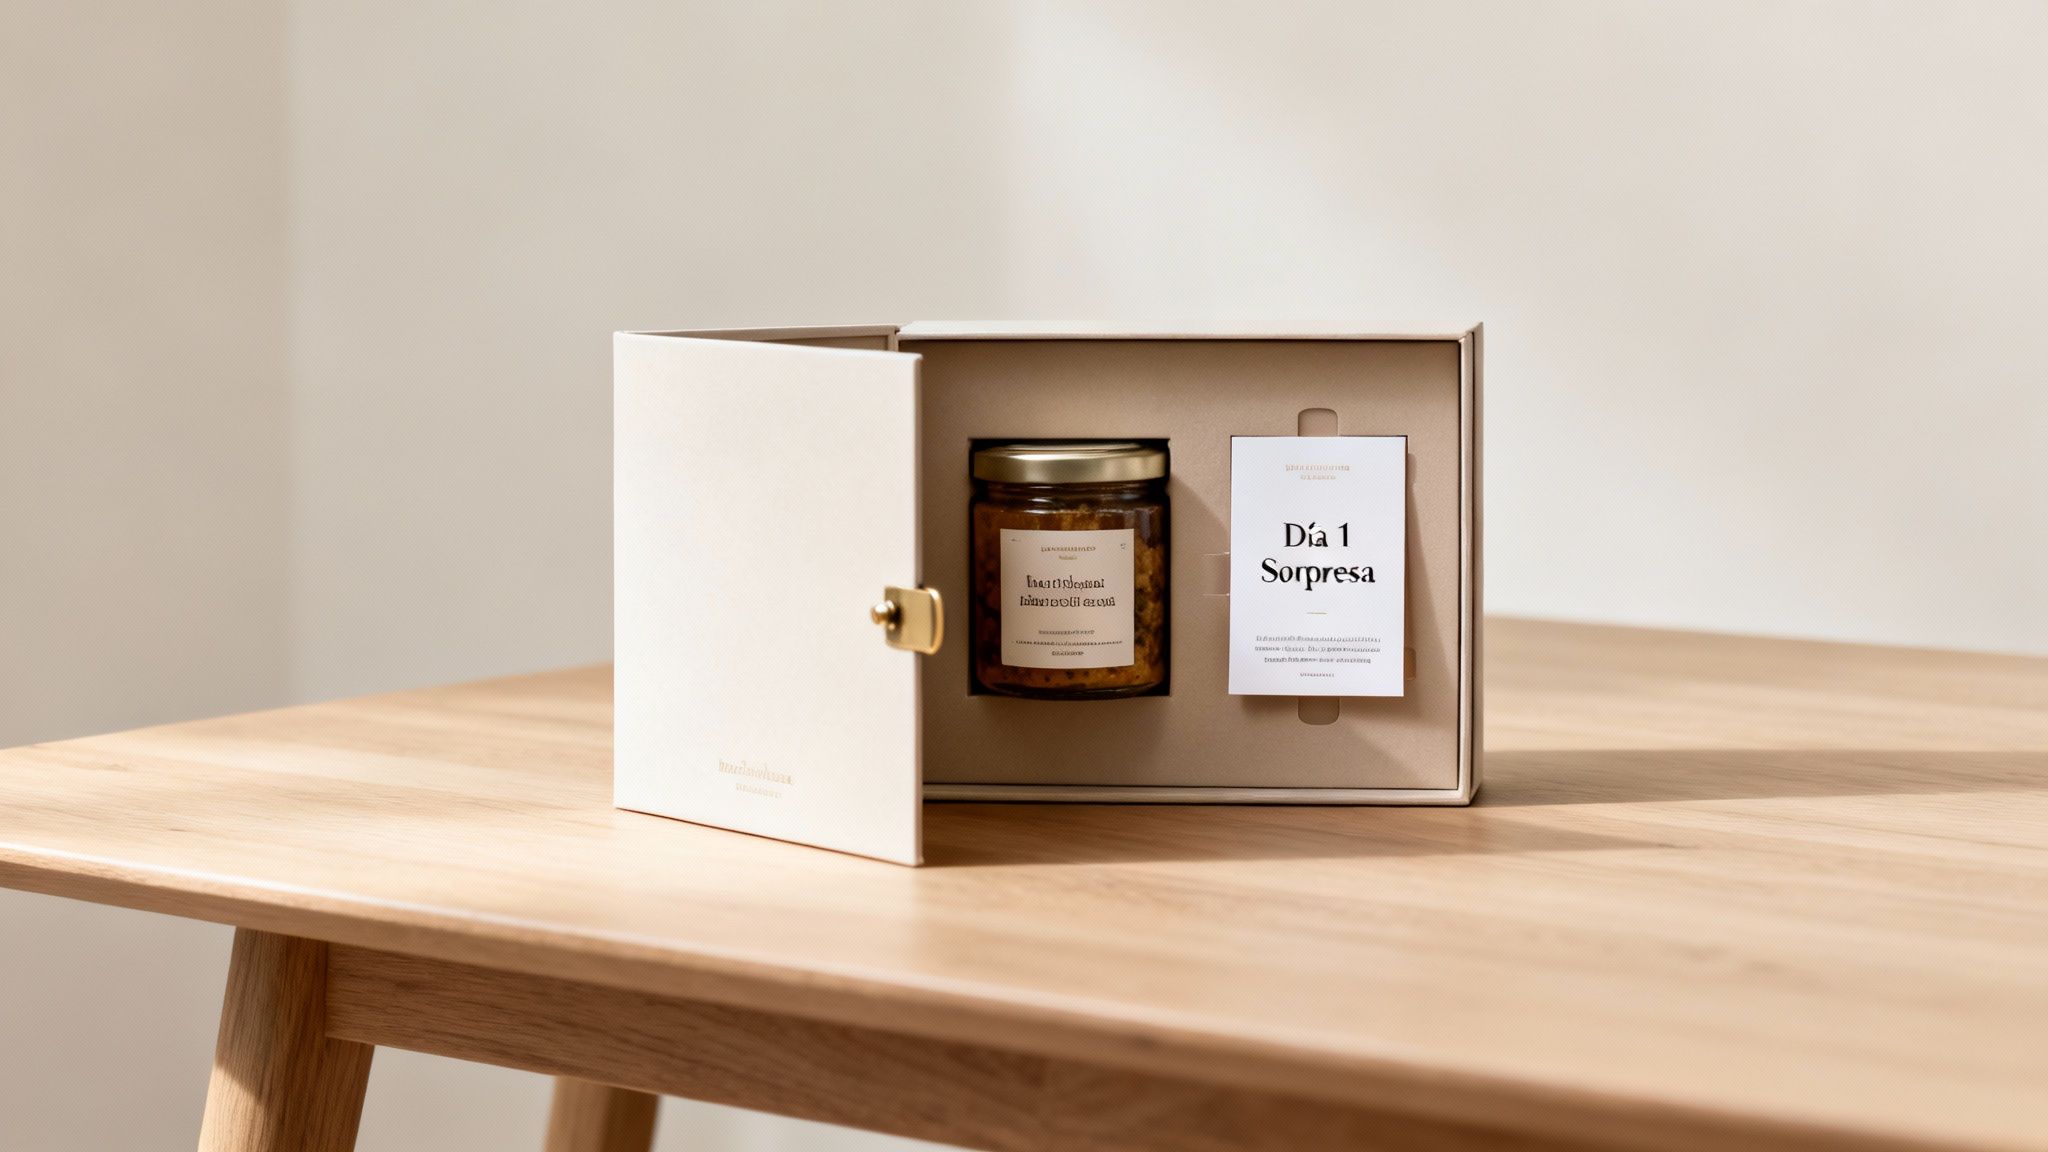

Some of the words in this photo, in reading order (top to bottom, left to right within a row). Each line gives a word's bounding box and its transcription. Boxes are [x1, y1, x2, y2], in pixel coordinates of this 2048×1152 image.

[1283, 521, 1329, 548] Día
[1338, 522, 1350, 548] 1
[1261, 558, 1376, 591] Sorpresa
